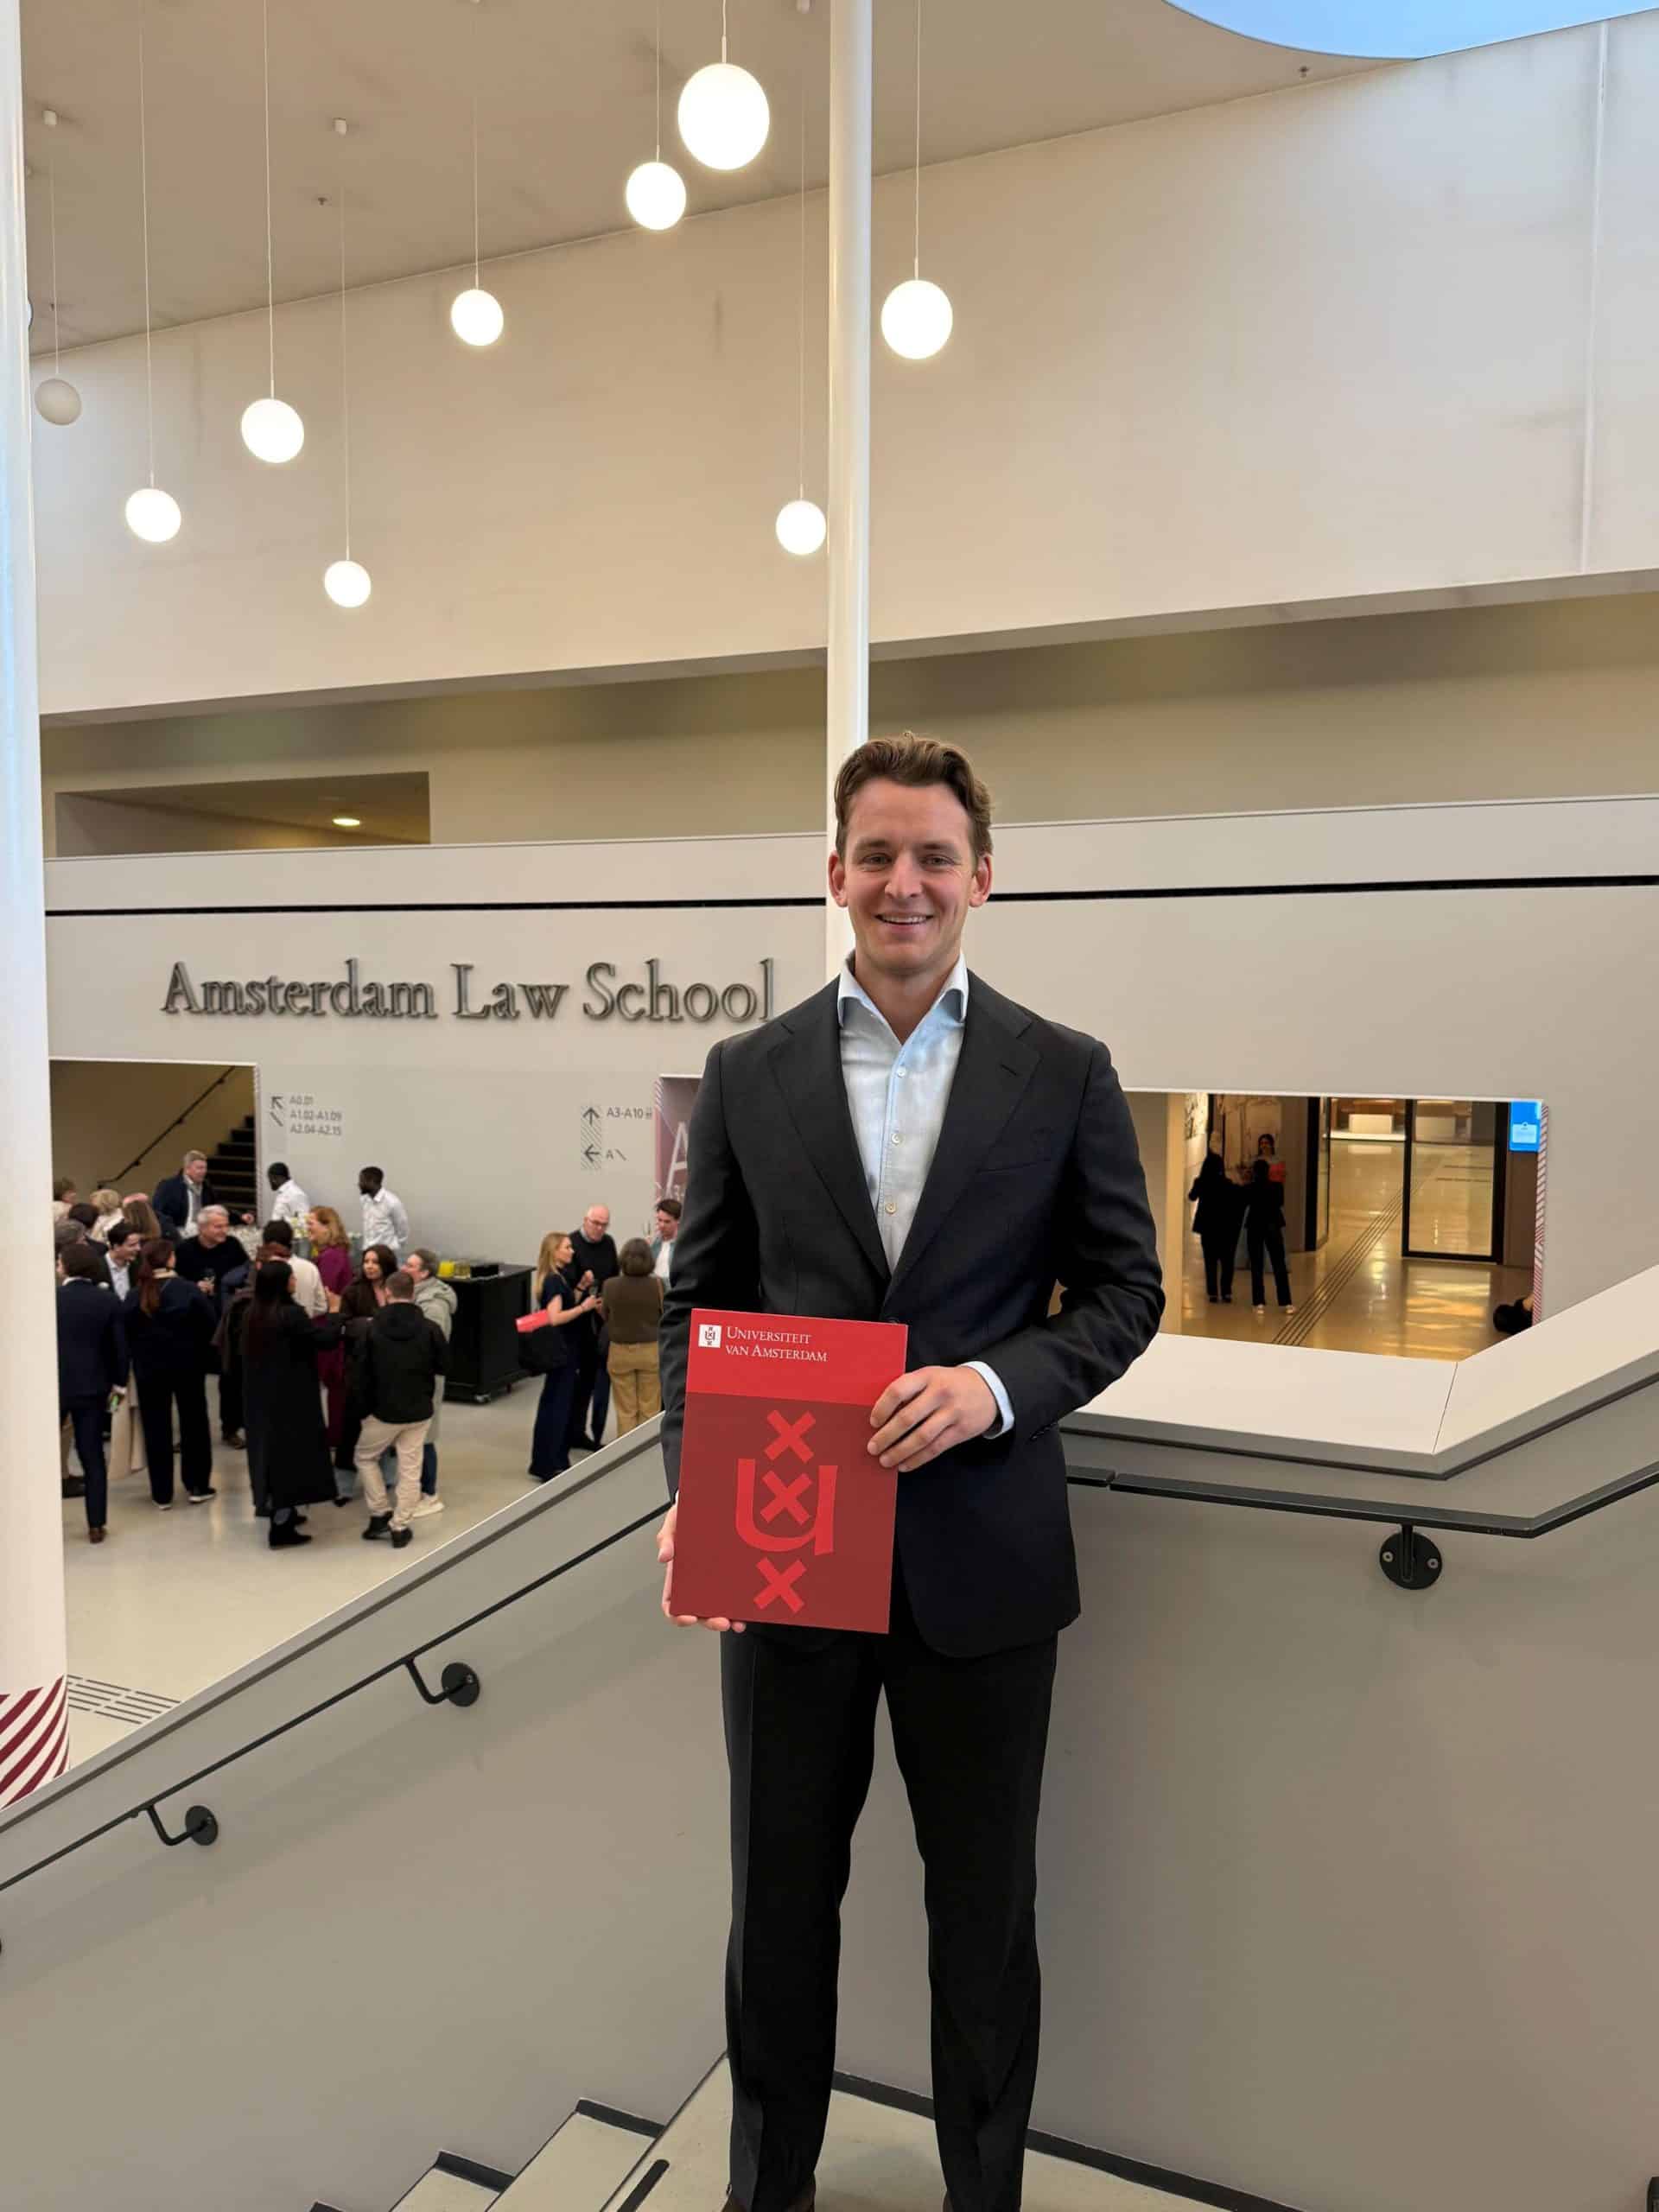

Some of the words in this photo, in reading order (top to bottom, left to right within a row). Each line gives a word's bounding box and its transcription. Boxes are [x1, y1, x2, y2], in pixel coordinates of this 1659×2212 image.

[161, 957, 438, 1018] Amsterdam
[450, 963, 569, 1020] Law
[582, 957, 774, 1023] School
[607, 1107, 644, 1119] A3-A10
